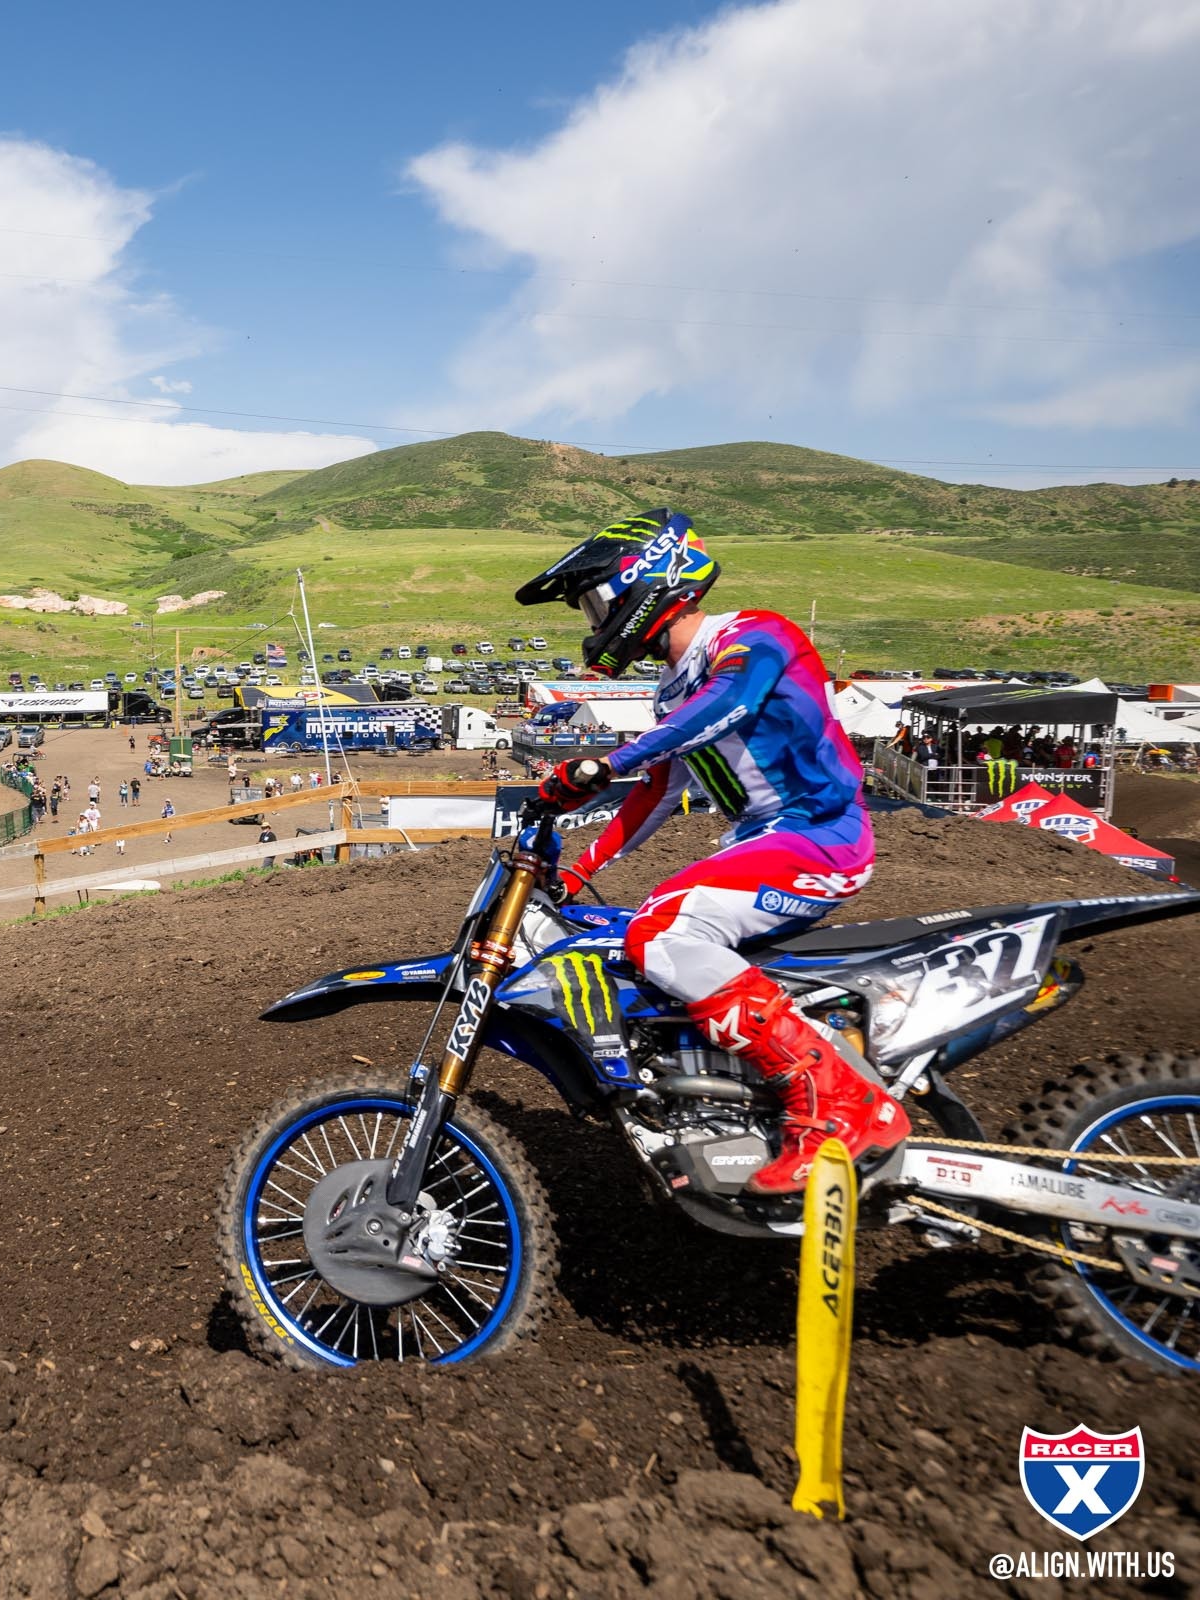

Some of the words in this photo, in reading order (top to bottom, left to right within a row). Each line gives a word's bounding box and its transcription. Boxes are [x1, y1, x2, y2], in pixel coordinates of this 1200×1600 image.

[621, 526, 679, 584] OAKLEY
[620, 592, 660, 639] MONSTER
[306, 721, 416, 733] MOTOCROSS
[1021, 772, 1094, 784] MONSTER
[916, 910, 973, 926] YAMAHA
[446, 977, 491, 1062] KYB
[821, 1183, 844, 1318] ACERBIS
